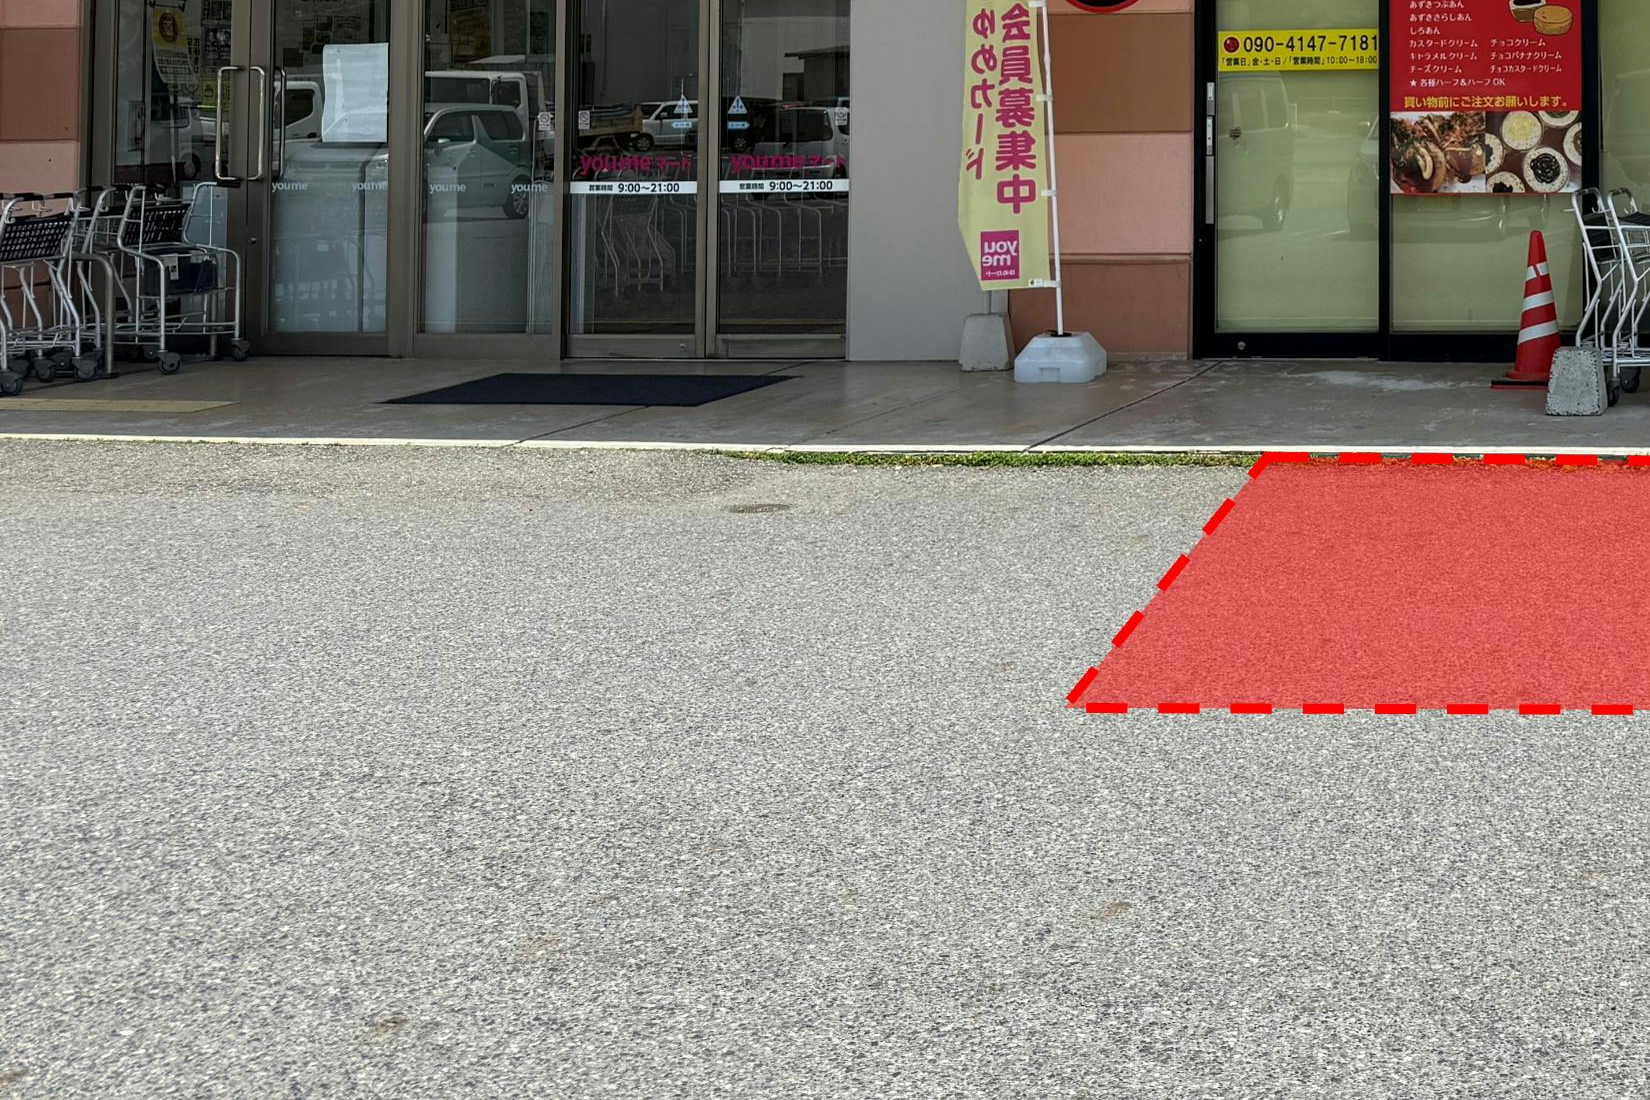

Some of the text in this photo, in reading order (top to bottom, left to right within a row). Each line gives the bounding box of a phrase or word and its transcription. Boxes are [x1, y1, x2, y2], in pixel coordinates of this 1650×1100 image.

[1409, 0, 1464, 9] あずきつぶあん
[1410, 26, 1441, 35] しろあん
[1244, 35, 1378, 53] 090-4147-7181
[1409, 38, 1478, 48] カスタードクリーム
[1490, 37, 1546, 47] チョコクリーム
[1409, 51, 1478, 61] キャラメルクリーム
[1409, 65, 1462, 74] チーズクリーム
[1404, 95, 1568, 109] 買い物前にご注文お願いします。
[580, 154, 651, 176] youme
[272, 181, 308, 193] youme
[430, 182, 466, 194] youme
[511, 182, 548, 194] youme
